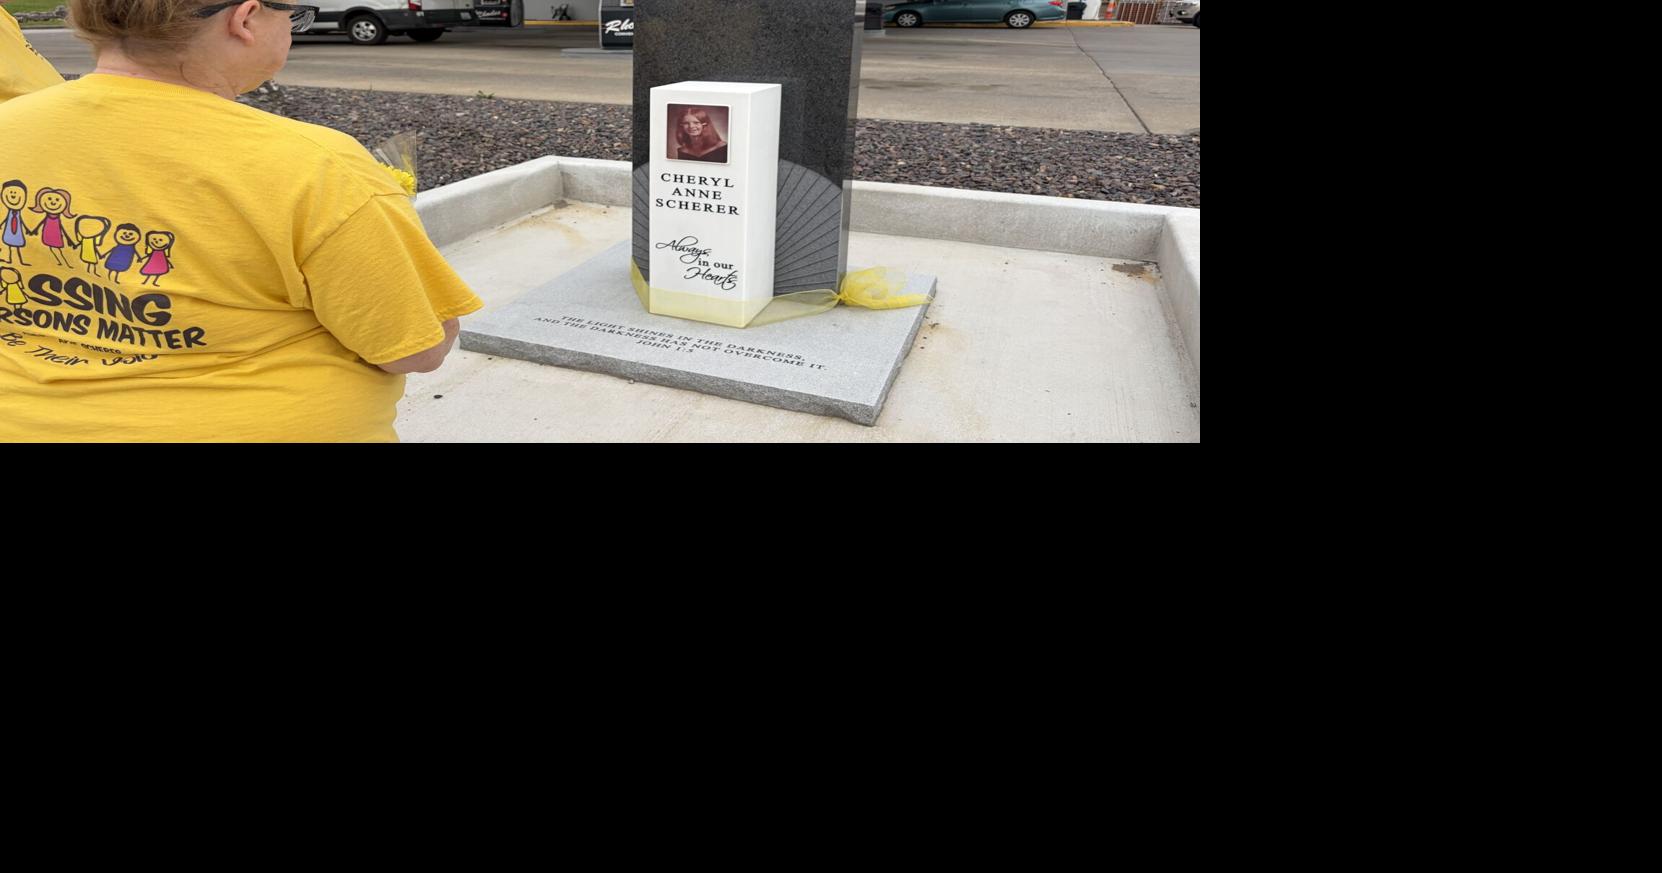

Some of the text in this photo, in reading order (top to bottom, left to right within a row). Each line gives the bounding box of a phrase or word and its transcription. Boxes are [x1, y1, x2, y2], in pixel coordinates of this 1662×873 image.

[660, 172, 735, 188] CHERYL
[671, 187, 722, 200] ANNE
[655, 198, 740, 215] SCHERER
[698, 258, 734, 270] in our
[683, 266, 738, 291] Hearts
[96, 318, 207, 350] MATTER
[586, 320, 626, 330] LIGHT
[627, 327, 674, 338] SHINES
[697, 338, 723, 346] THE
[563, 321, 587, 329] THE
[590, 326, 657, 341] DARKNESS
[660, 337, 688, 346] HAS
[691, 343, 720, 352] NOT
[723, 349, 806, 367] OVERCOME
[636, 339, 671, 349] JOHN
[25, 345, 88, 366] Their
